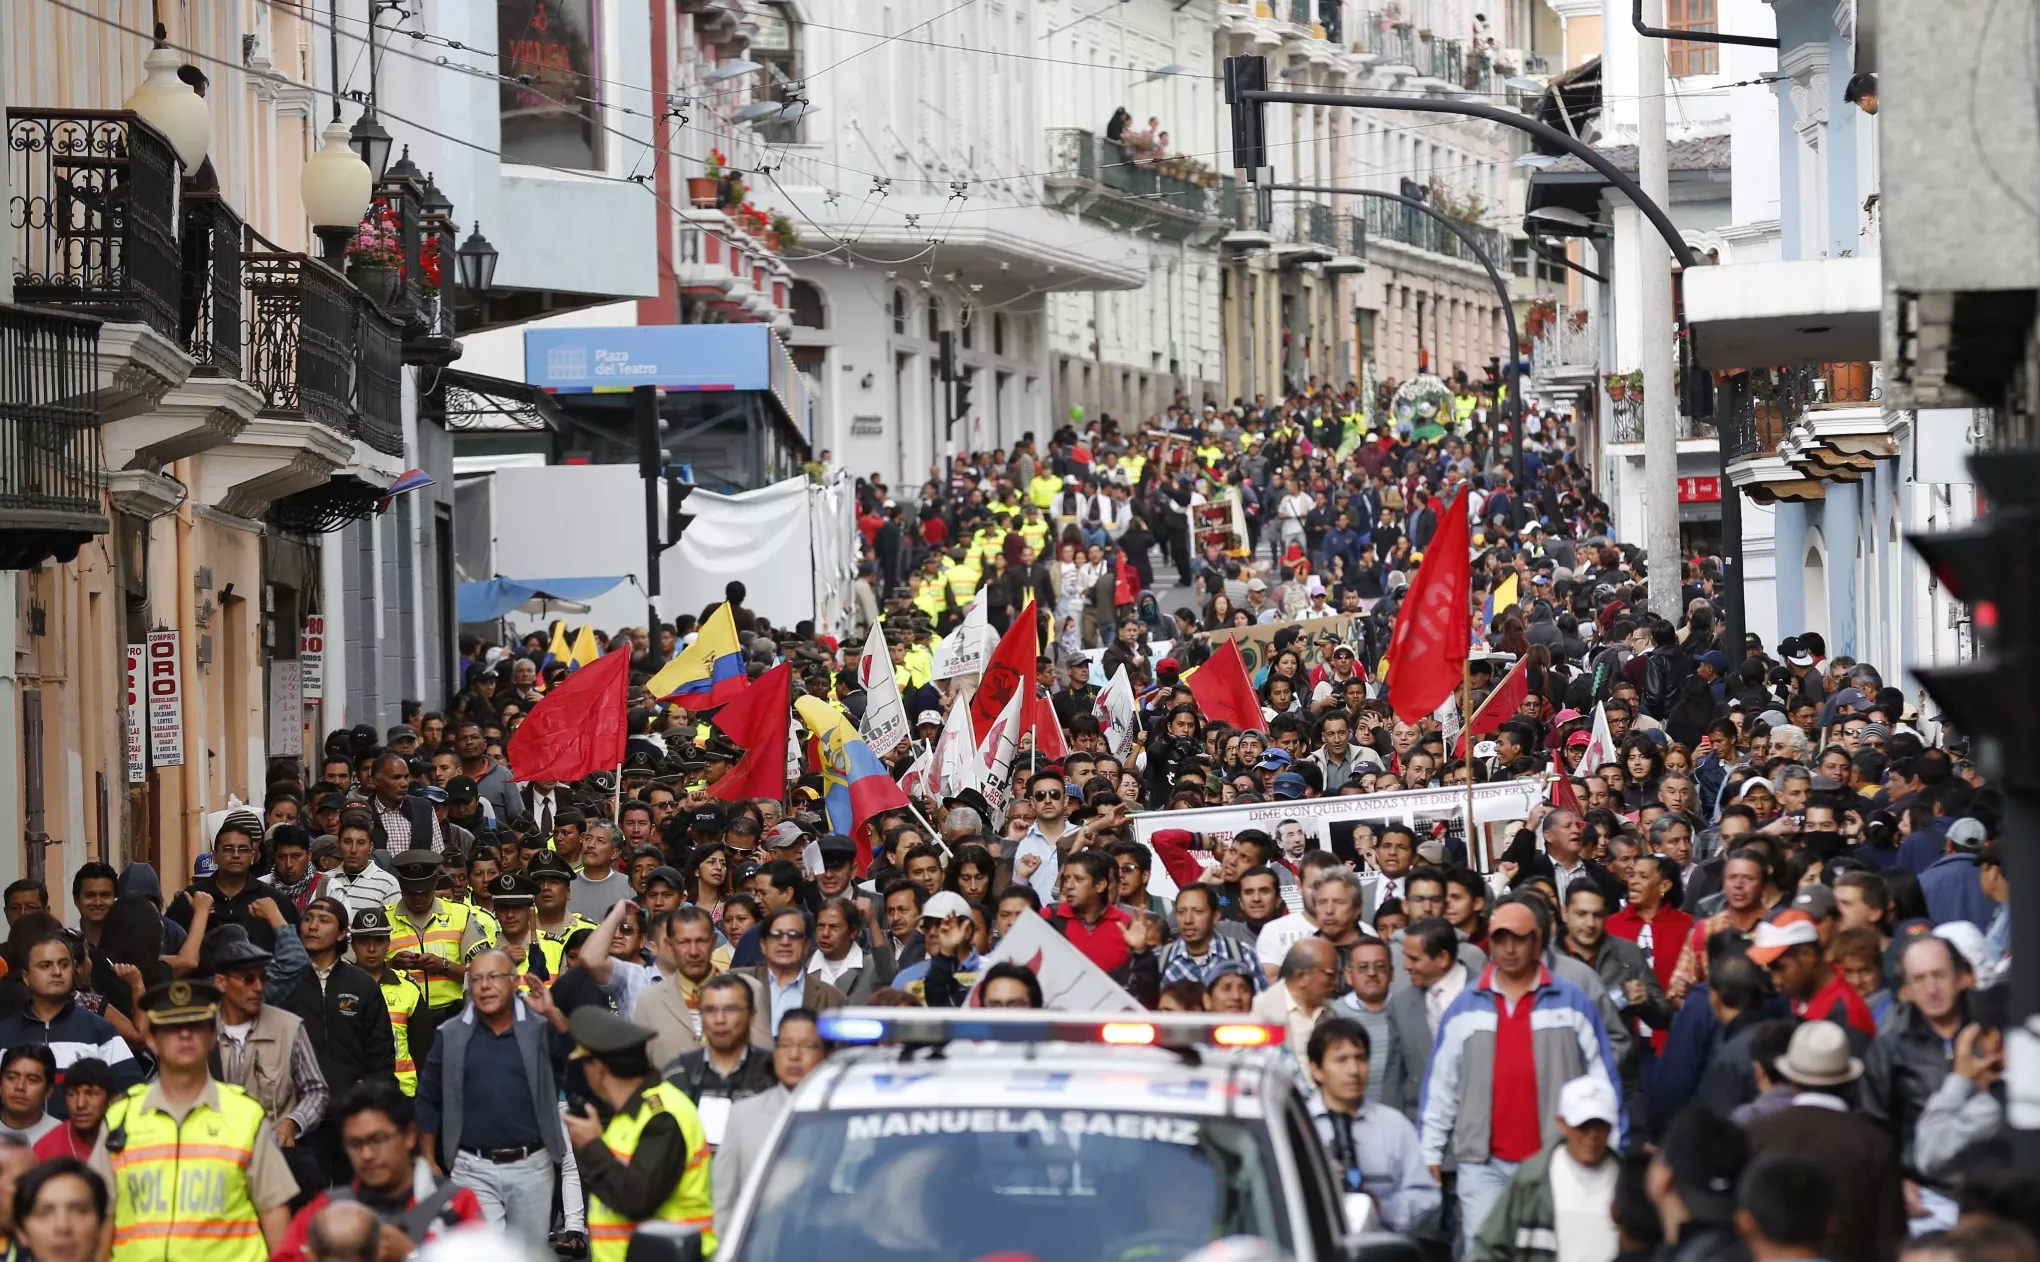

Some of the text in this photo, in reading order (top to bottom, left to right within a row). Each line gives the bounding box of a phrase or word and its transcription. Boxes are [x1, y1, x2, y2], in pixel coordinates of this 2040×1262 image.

[595, 349, 629, 362] Plaza
[595, 362, 657, 375] del Teatro
[151, 642, 176, 695] ORO
[1249, 784, 1536, 821] DIME CON QUIEN ANDAS Y TE DIRÉ QUIEN ERES
[847, 1109, 1201, 1146] MANUELA SAENZ
[128, 1168, 226, 1214] POLICIA
